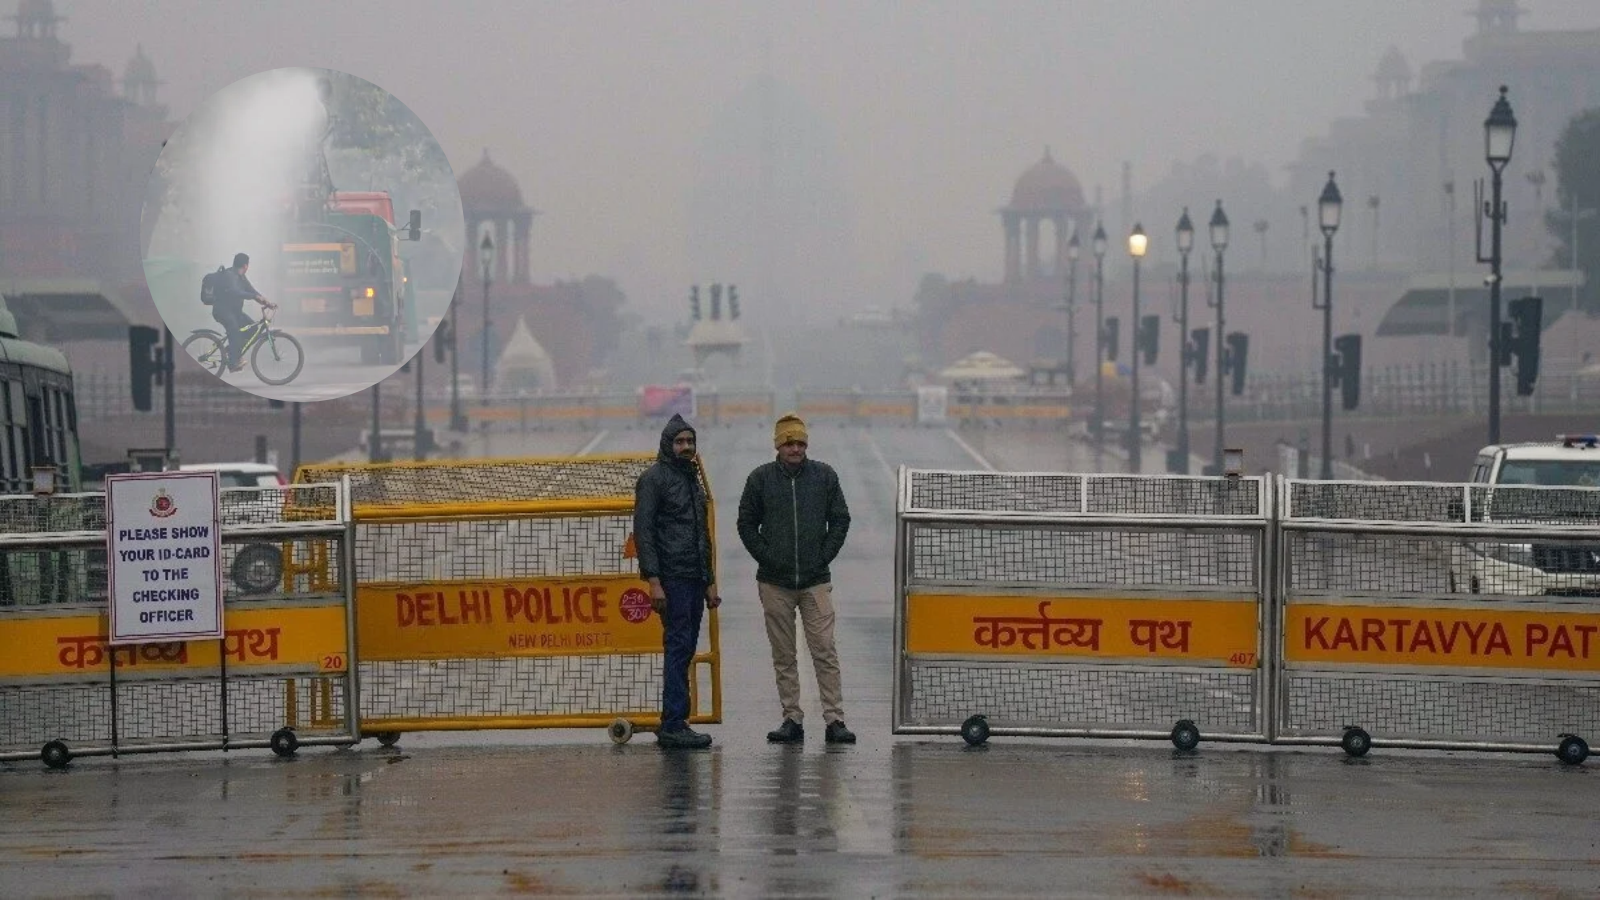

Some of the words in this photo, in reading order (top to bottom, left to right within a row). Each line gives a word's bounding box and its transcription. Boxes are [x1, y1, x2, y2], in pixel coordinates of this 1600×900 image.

[119, 527, 168, 541] PLEASE
[171, 526, 209, 539] SHOW
[119, 549, 155, 562] YOUR
[158, 546, 210, 560] ID-CARD
[142, 569, 160, 582] TO
[162, 568, 189, 581] THE
[132, 588, 200, 603] CHECKING
[396, 590, 493, 628] DELHI
[503, 586, 609, 625] POLICE
[139, 609, 194, 624] OFFICER
[508, 635, 537, 649] NEW
[540, 634, 572, 648] DELHI
[1129, 619, 1192, 652] पथ
[1304, 616, 1513, 656] KARTAVYA
[1525, 623, 1599, 659] PAT
[223, 627, 280, 661] पथ
[323, 655, 343, 670] 20
[1230, 653, 1255, 665] 407
